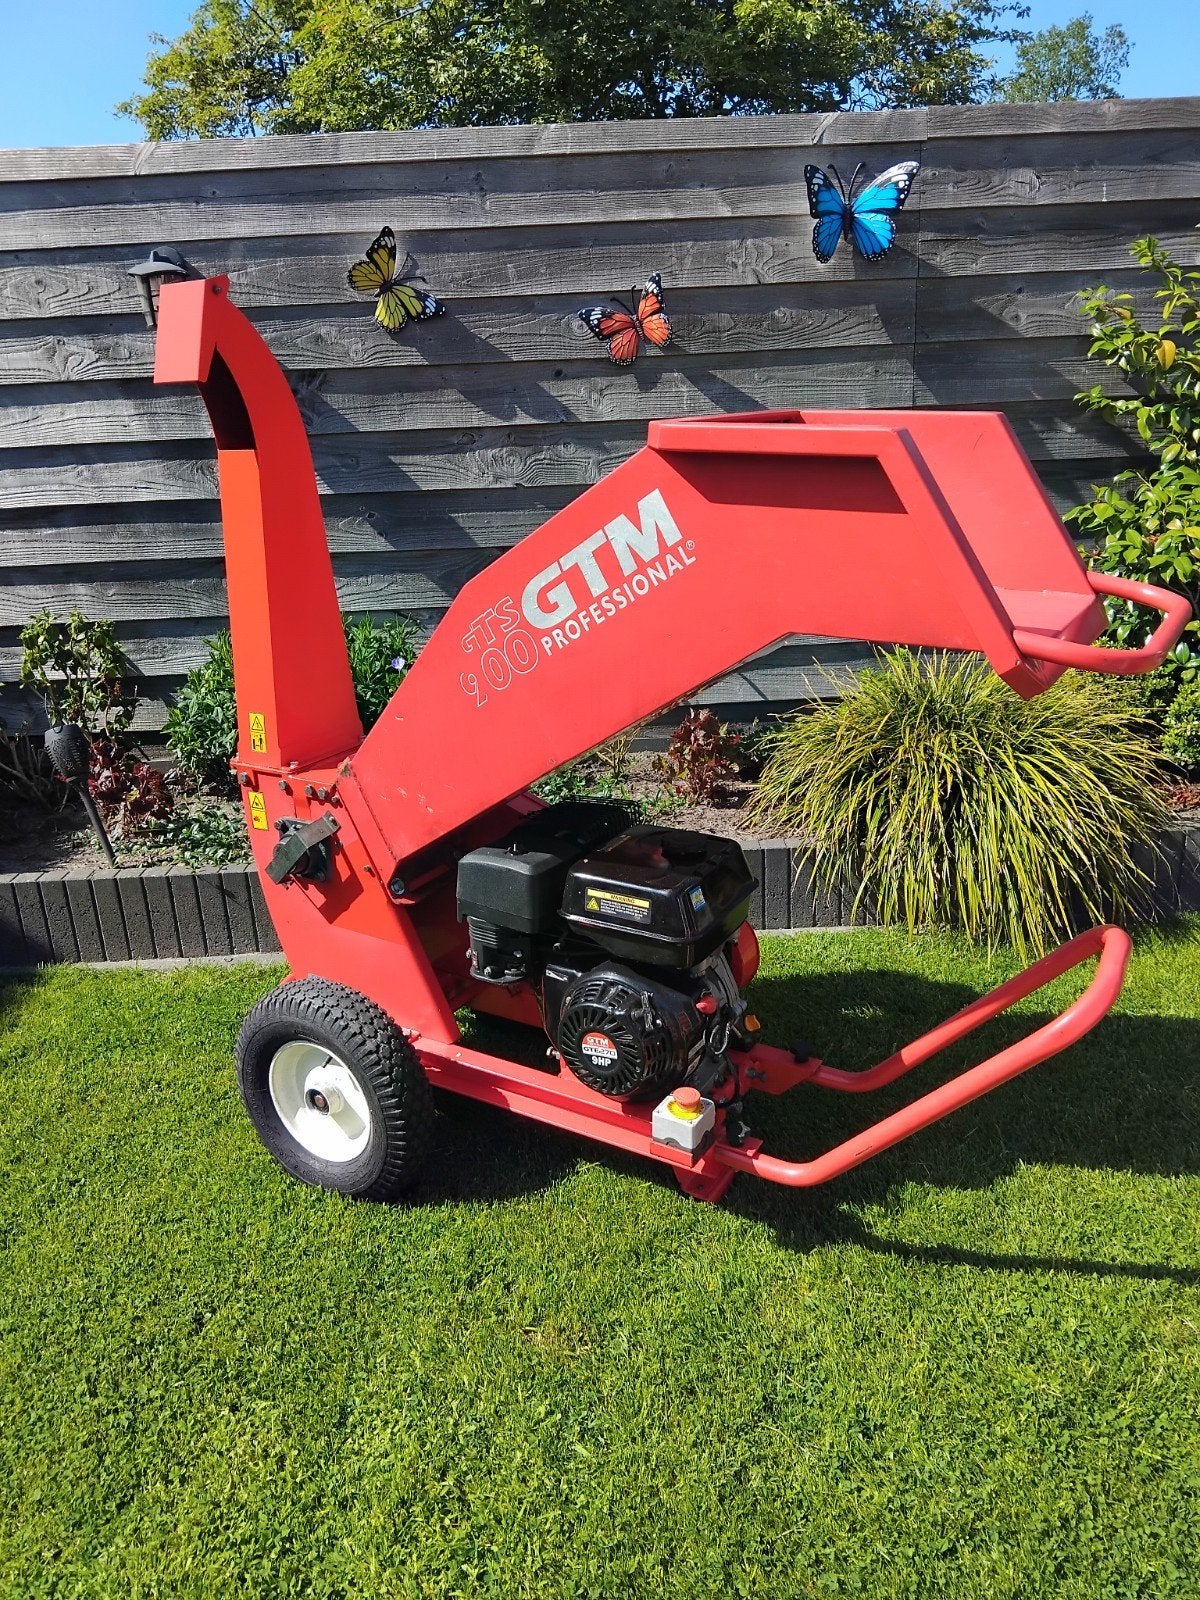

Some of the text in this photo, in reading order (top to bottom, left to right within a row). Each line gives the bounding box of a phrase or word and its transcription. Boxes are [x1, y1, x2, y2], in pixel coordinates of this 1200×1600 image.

[521, 488, 684, 629] GTM
[540, 545, 697, 656] PROFESSIONAL
[461, 596, 521, 653] GTS
[583, 1046, 616, 1057] GTE270
[587, 1036, 609, 1046] GTM
[591, 1056, 612, 1067] 9HP
